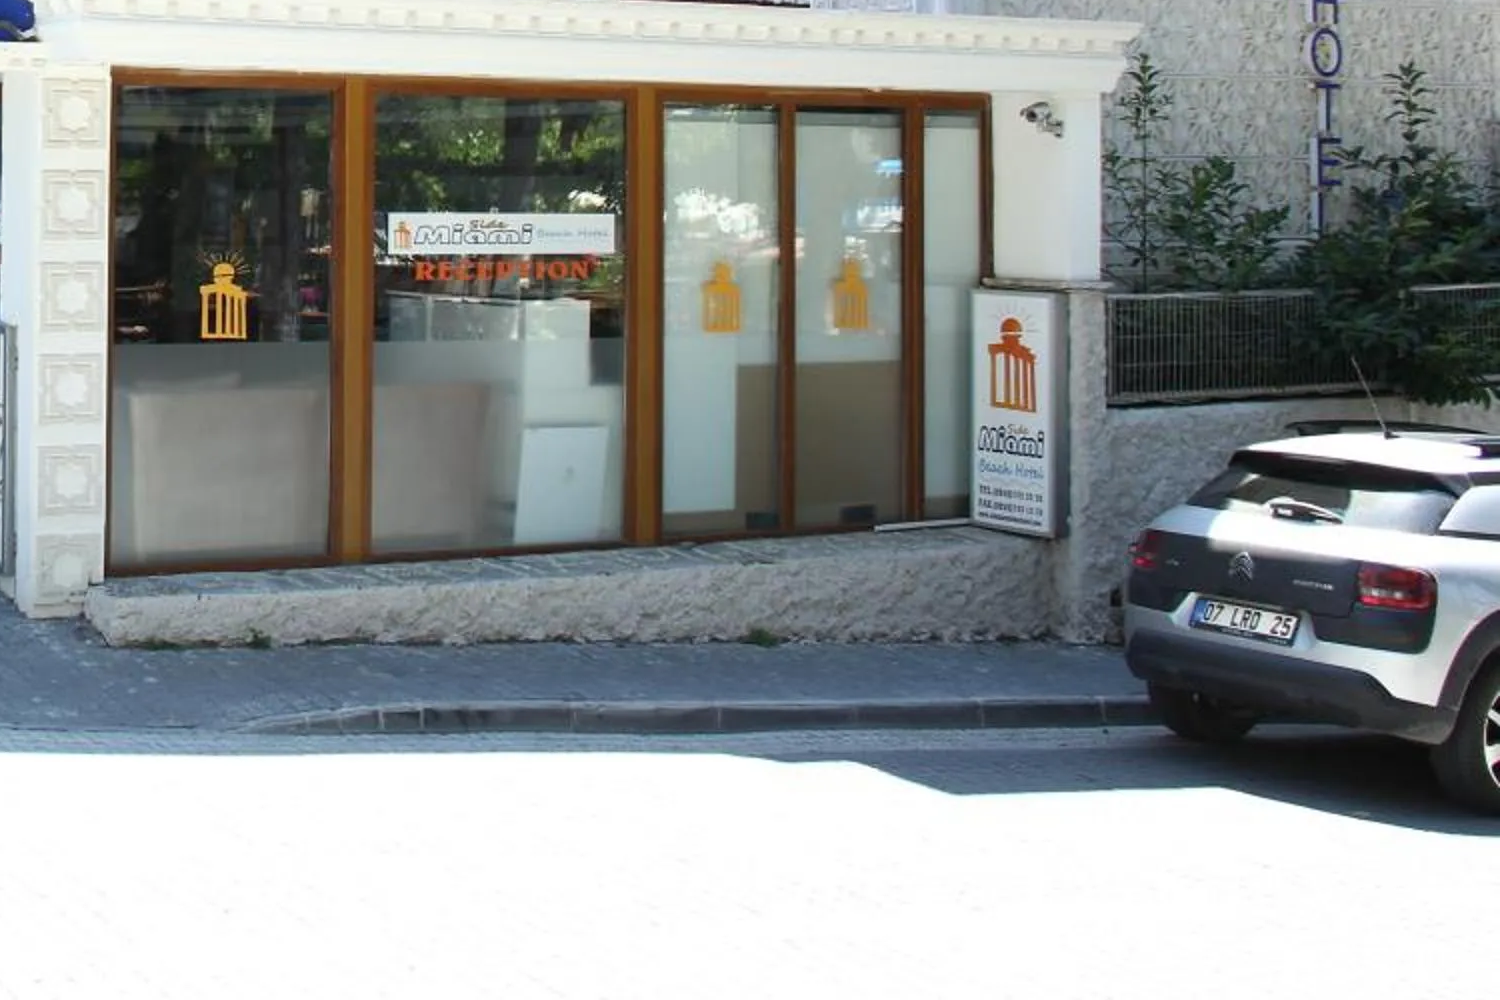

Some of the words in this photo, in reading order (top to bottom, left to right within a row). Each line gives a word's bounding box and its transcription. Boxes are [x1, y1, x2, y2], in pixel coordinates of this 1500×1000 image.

[413, 222, 533, 245] Miami
[414, 258, 592, 281] RECEPTION
[978, 425, 1045, 459] Miami
[1203, 603, 1225, 622] 07
[1270, 615, 1293, 637] 25
